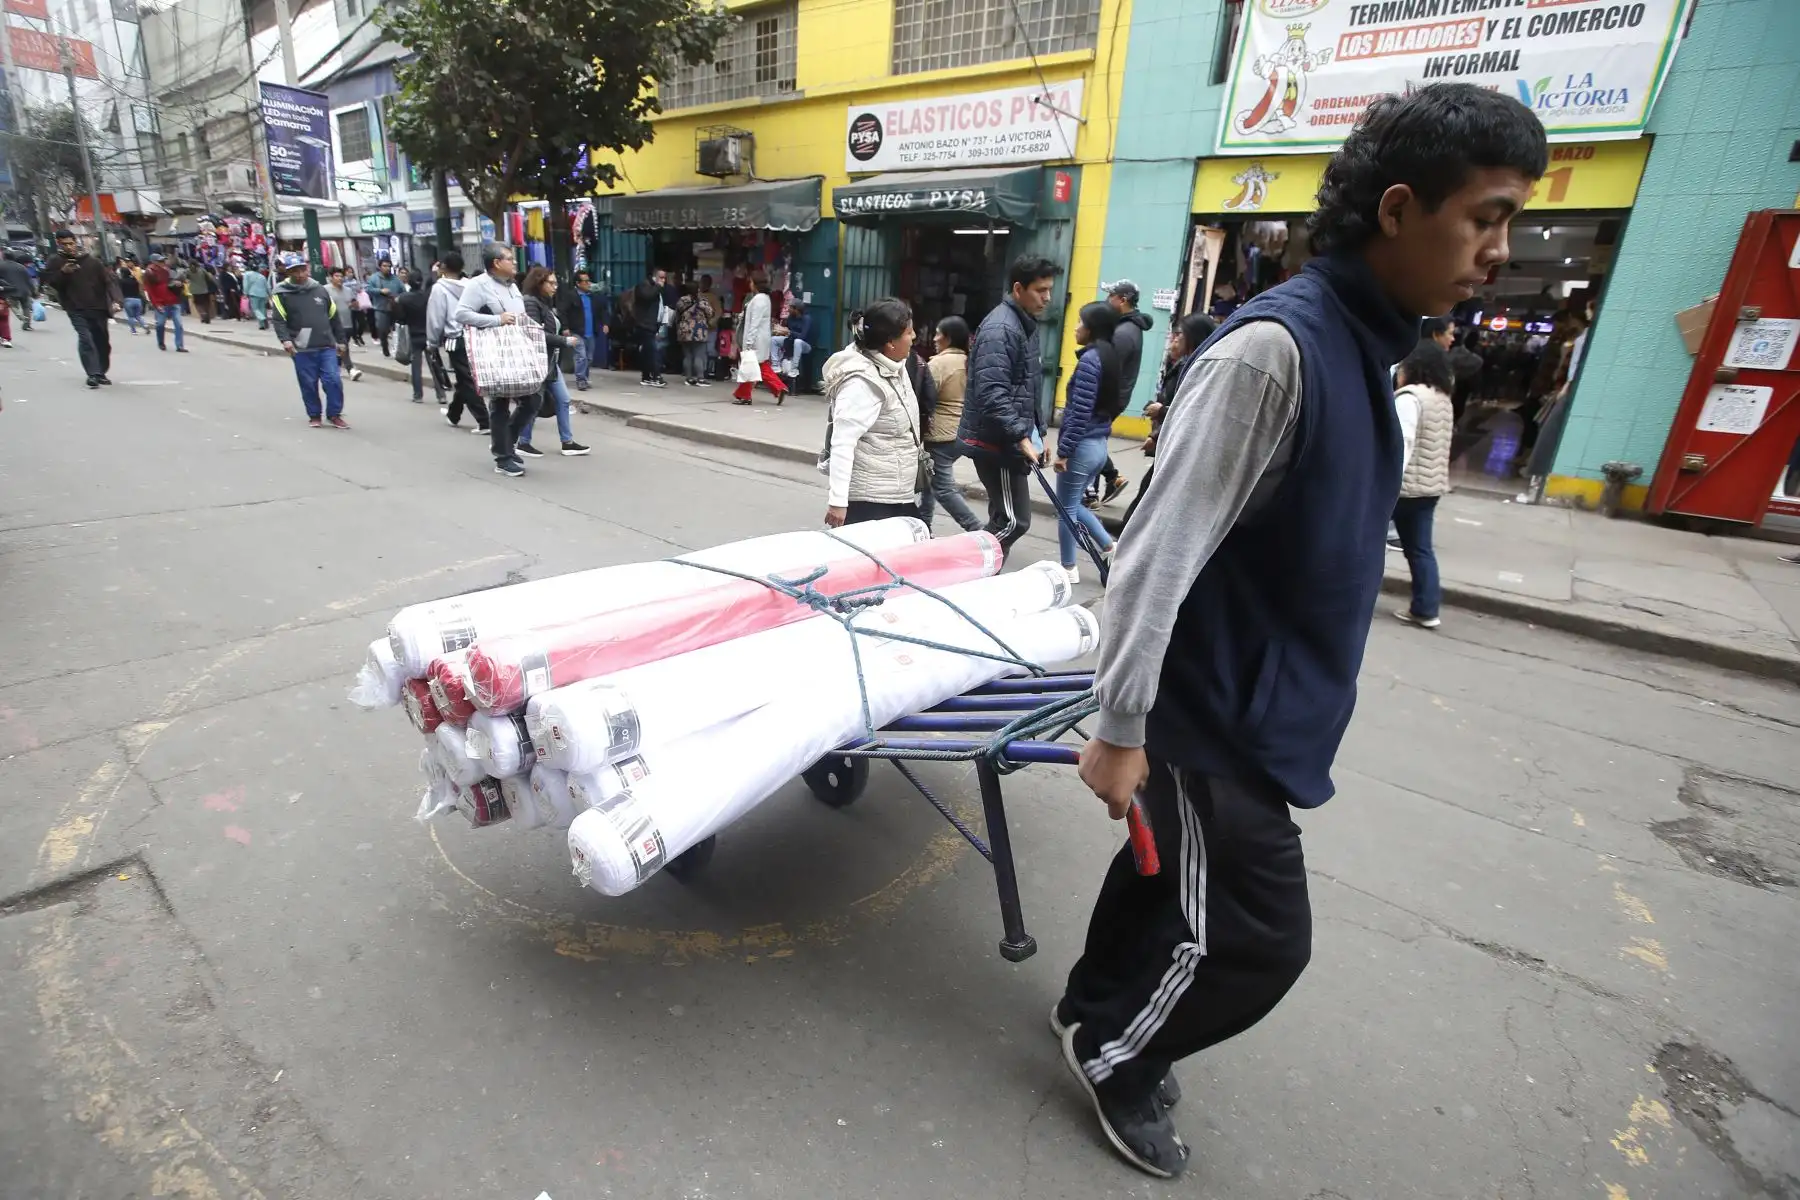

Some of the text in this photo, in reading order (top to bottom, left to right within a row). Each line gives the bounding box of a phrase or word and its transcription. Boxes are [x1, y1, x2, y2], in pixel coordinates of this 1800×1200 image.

[1339, 3, 1646, 57] LOS JALADORES Y EL COMERCIO
[1423, 49, 1521, 78] INFORMAL
[1565, 72, 1593, 89] LA
[1516, 78, 1629, 109] VICTORIA
[262, 99, 324, 117] ILUMINACIÓN
[263, 107, 281, 117] LED
[292, 114, 311, 123] todo
[886, 91, 1072, 136] ELASTICOS PYSA
[264, 116, 312, 132] Gamarra
[851, 131, 880, 144] PYSA
[899, 141, 935, 151] ANTONIO
[936, 138, 960, 149] BAZO
[973, 136, 988, 146] 737
[995, 135, 1007, 144] LA
[1009, 129, 1052, 142] VICTORIA
[269, 145, 288, 157] 50
[968, 146, 1004, 158] 309-3100
[1011, 143, 1050, 155] 475-6820
[1551, 145, 1597, 161] BAZO
[1527, 166, 1574, 203] 1
[840, 190, 988, 213] ELASTICOS PYSA
[722, 207, 747, 221] 735
